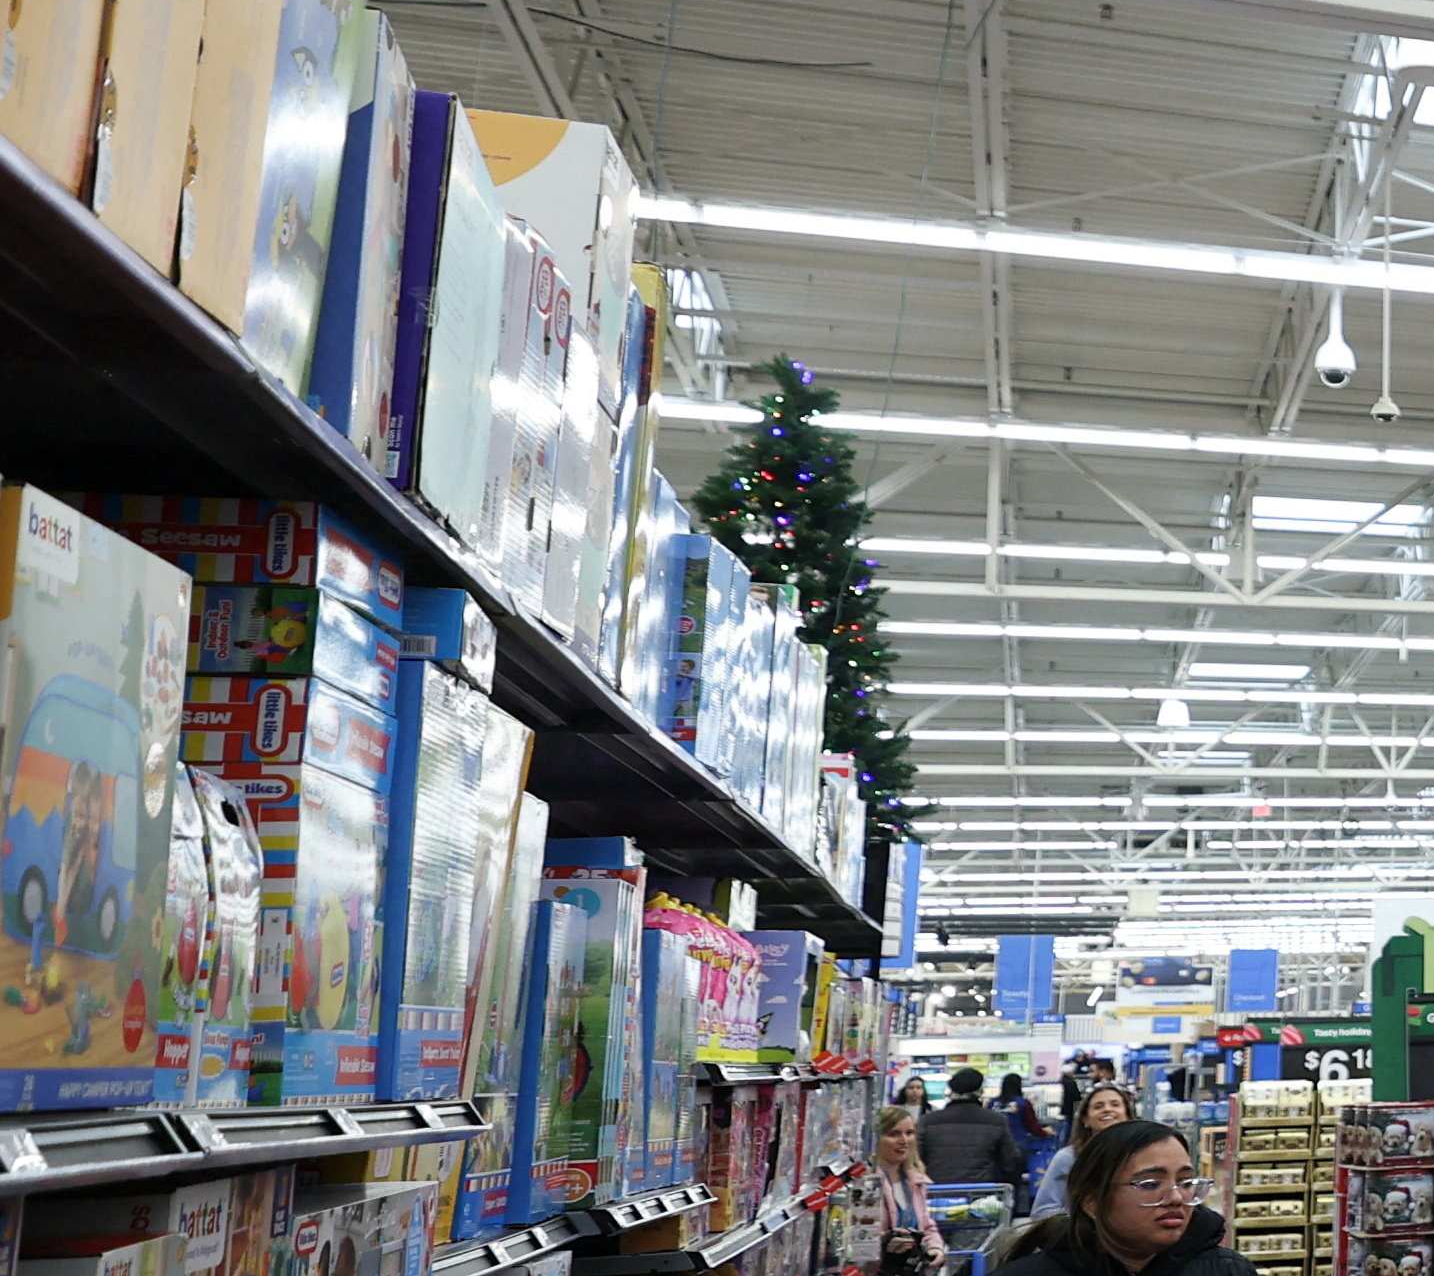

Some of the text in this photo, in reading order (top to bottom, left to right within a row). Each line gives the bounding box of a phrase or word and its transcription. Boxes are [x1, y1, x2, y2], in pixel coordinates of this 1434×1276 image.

[28, 501, 73, 553] battat
[265, 688, 284, 721] little
[178, 1195, 223, 1238] battat
